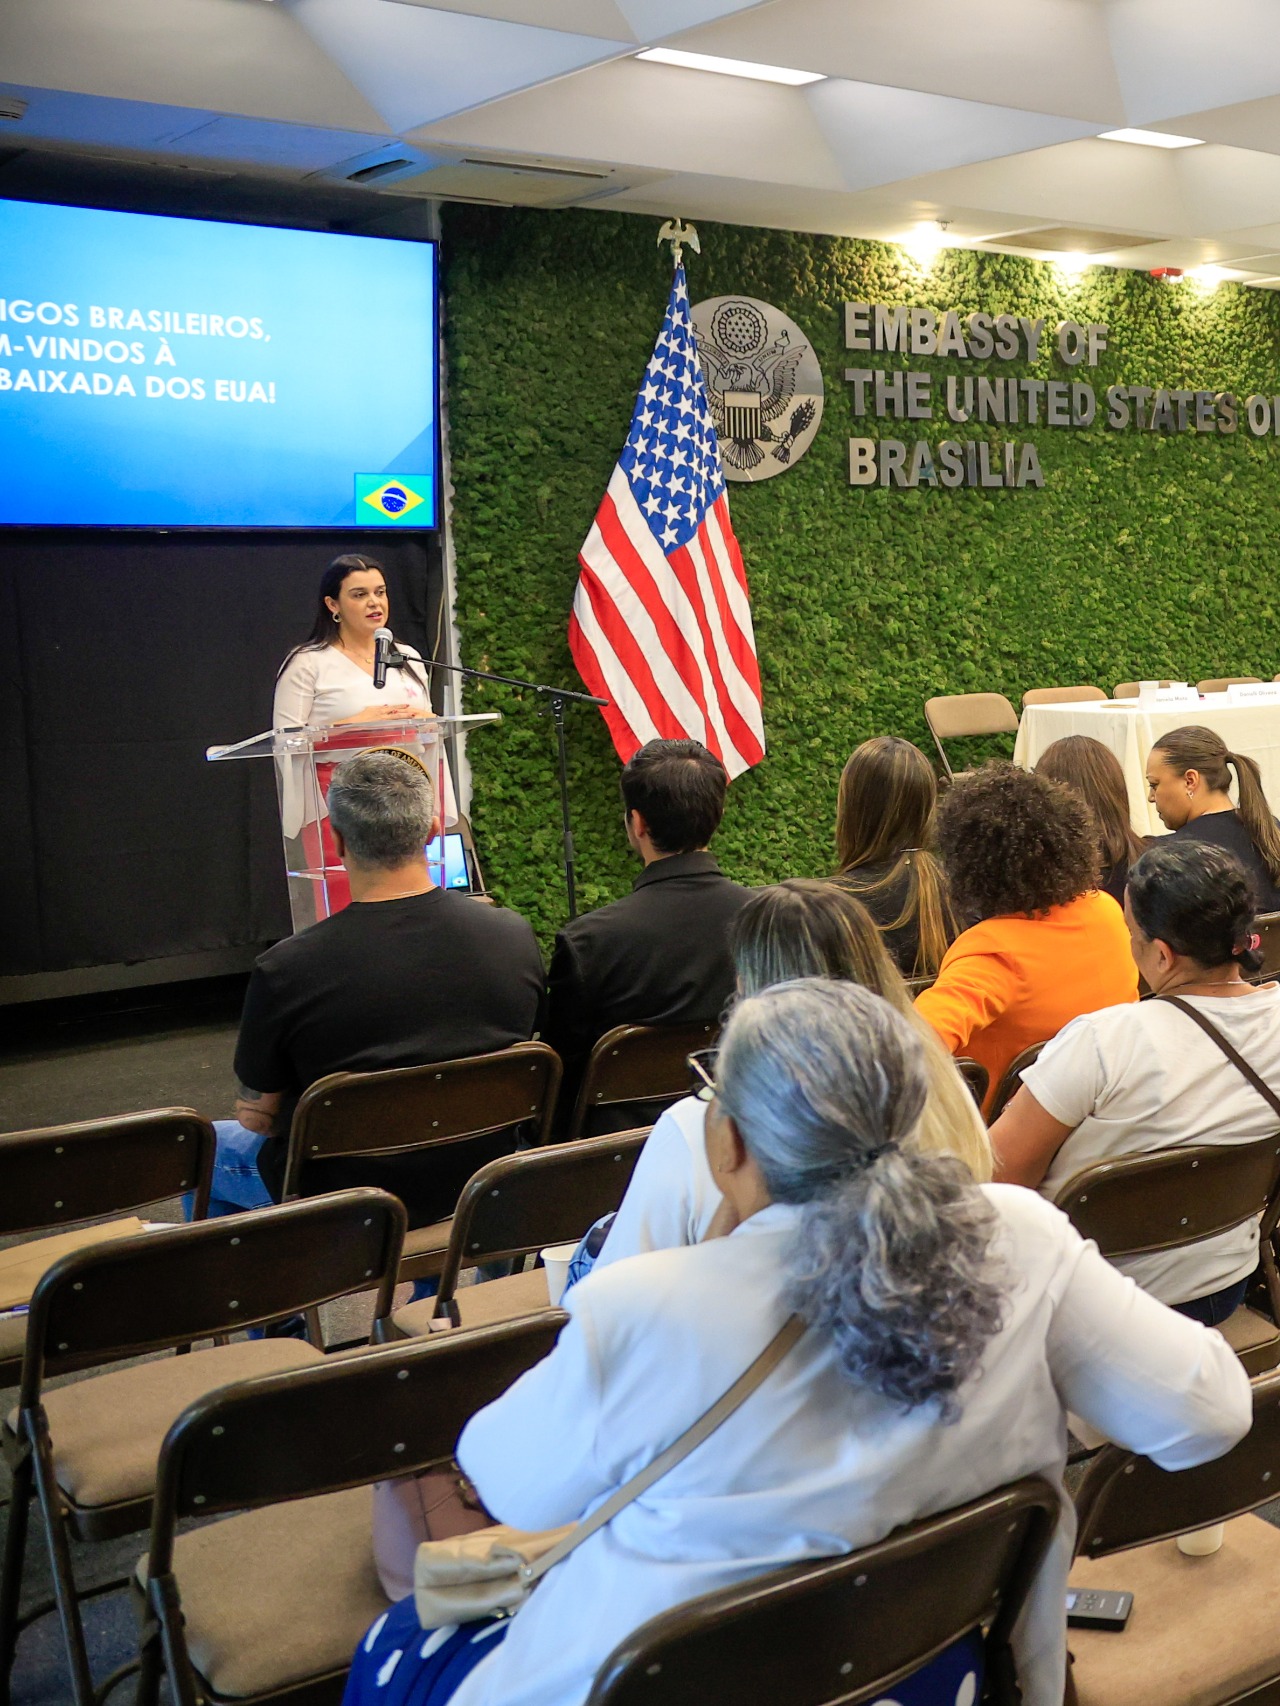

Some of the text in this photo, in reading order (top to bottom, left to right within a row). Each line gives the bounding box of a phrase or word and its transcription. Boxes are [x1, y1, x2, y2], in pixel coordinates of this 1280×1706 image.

[89, 305, 272, 343] BRASILEIROS,
[844, 301, 1110, 367] EMBASSY OF
[154, 337, 177, 366] À
[0, 367, 277, 404] BAIXADA DOS EUA!
[844, 368, 934, 419] THE
[946, 375, 1096, 428] UNITED
[1107, 384, 1238, 434] STATES
[848, 437, 1046, 488] BRASILIA
